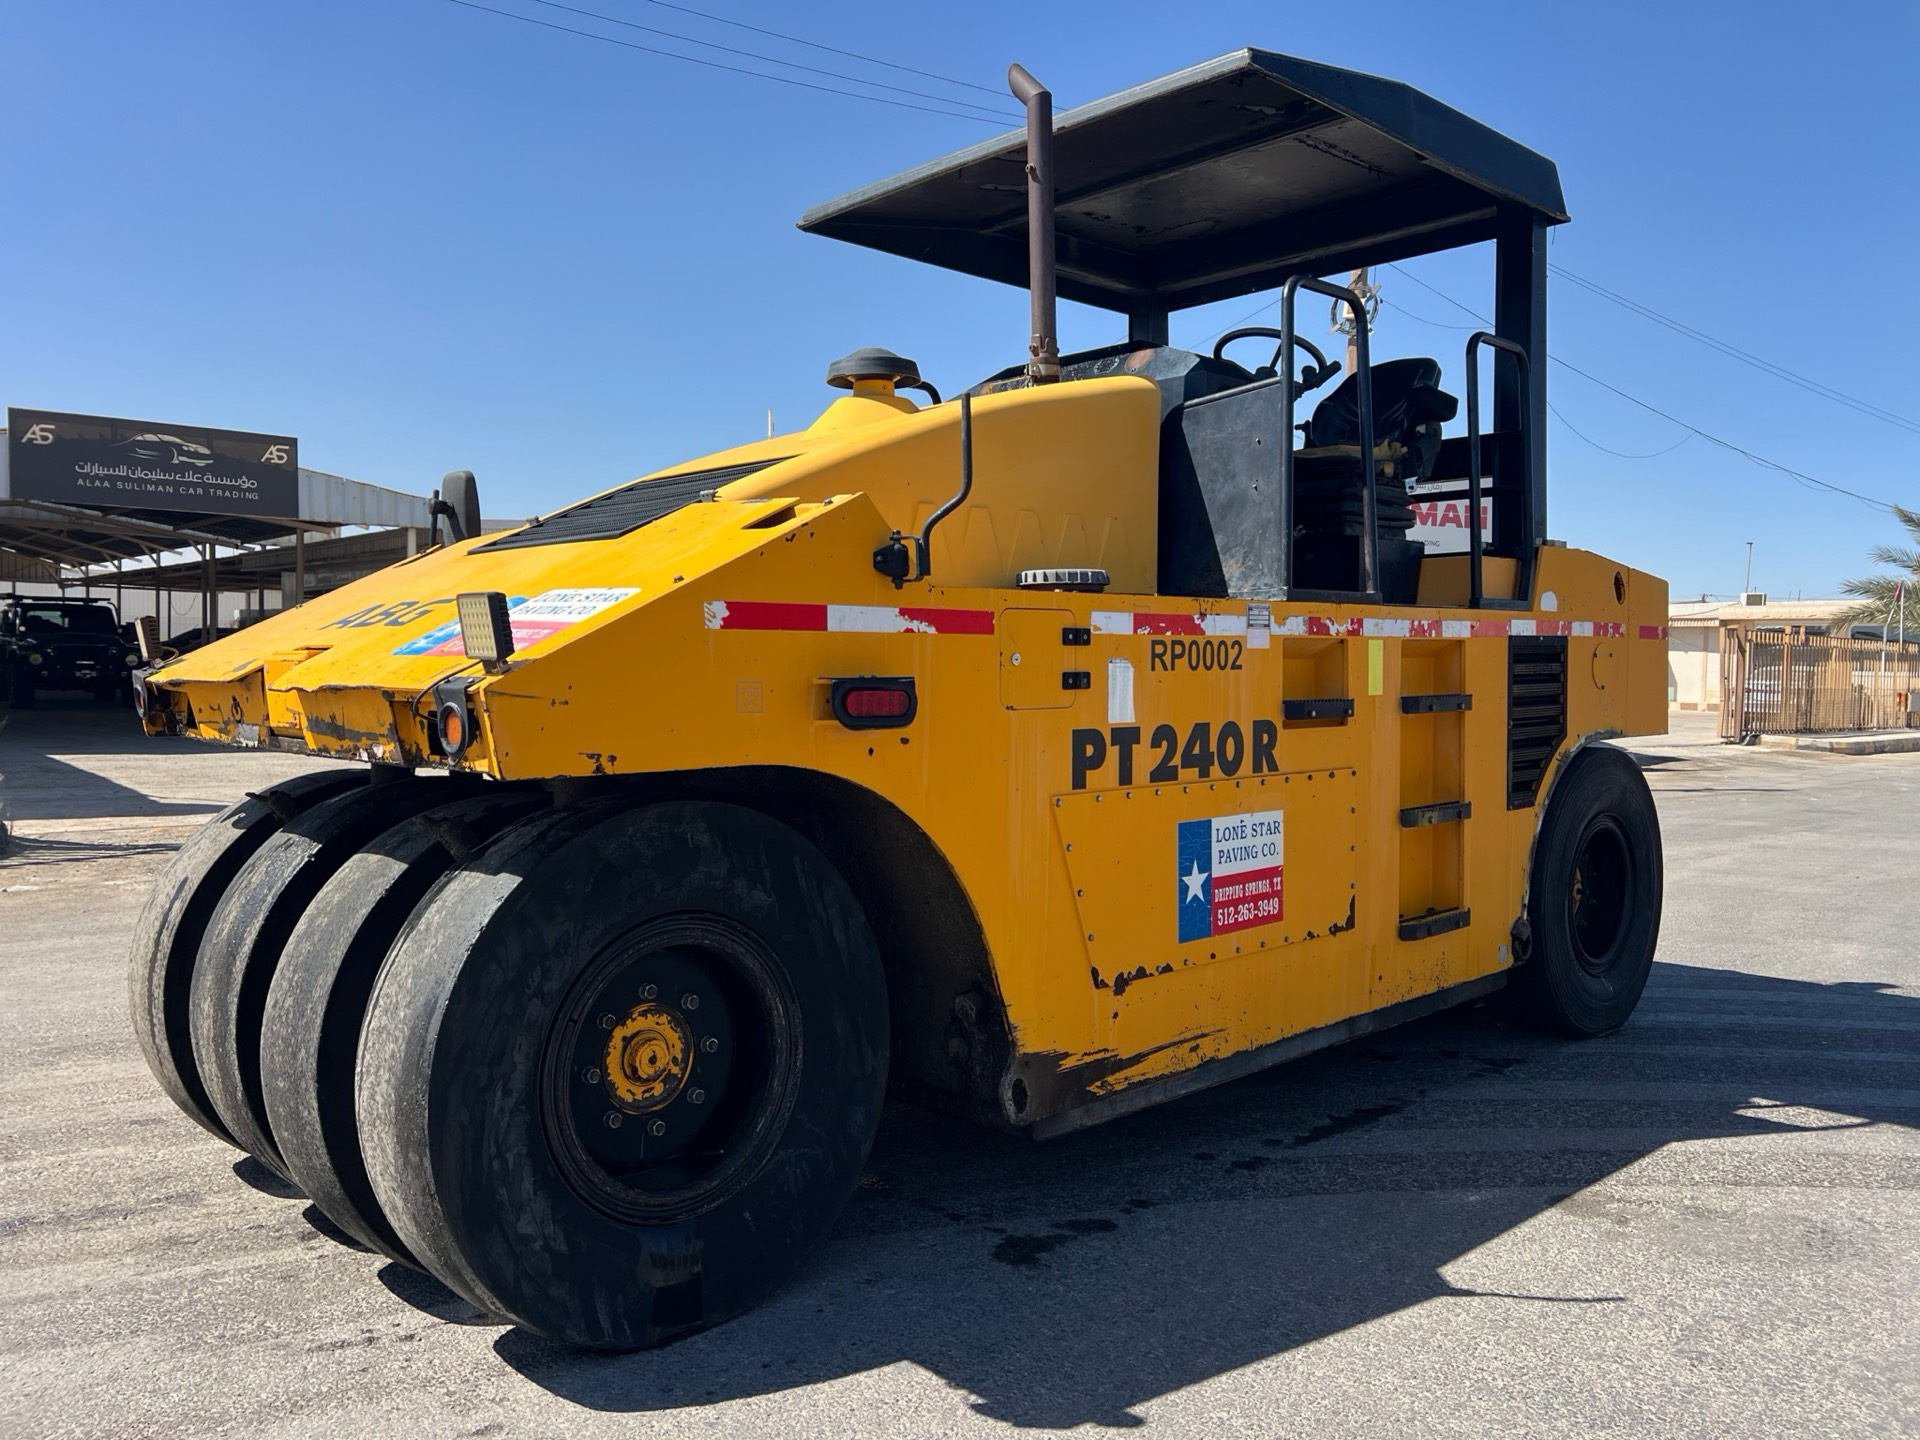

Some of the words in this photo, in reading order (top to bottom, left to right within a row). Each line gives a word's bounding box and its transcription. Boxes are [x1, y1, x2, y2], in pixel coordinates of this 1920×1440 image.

[75, 461, 127, 477] للسيارات
[128, 466, 175, 481] سليمان
[176, 470, 202, 483] علاء
[77, 478, 110, 488] ALAA
[116, 481, 174, 493] SULIMAN
[179, 486, 203, 496] CAR
[209, 488, 259, 500] TRADING
[204, 472, 257, 489] مؤسسة
[1151, 639, 1243, 672] RP0002
[1216, 824, 1247, 843] LONE
[1251, 821, 1281, 838] STAR
[1218, 845, 1258, 865] PAVING
[1261, 842, 1279, 857] CO.
[1214, 884, 1243, 903] DRIPPING
[1245, 879, 1272, 896] SPRINGS,
[1273, 877, 1282, 891] TX
[1217, 897, 1279, 926] 512-263-3949
